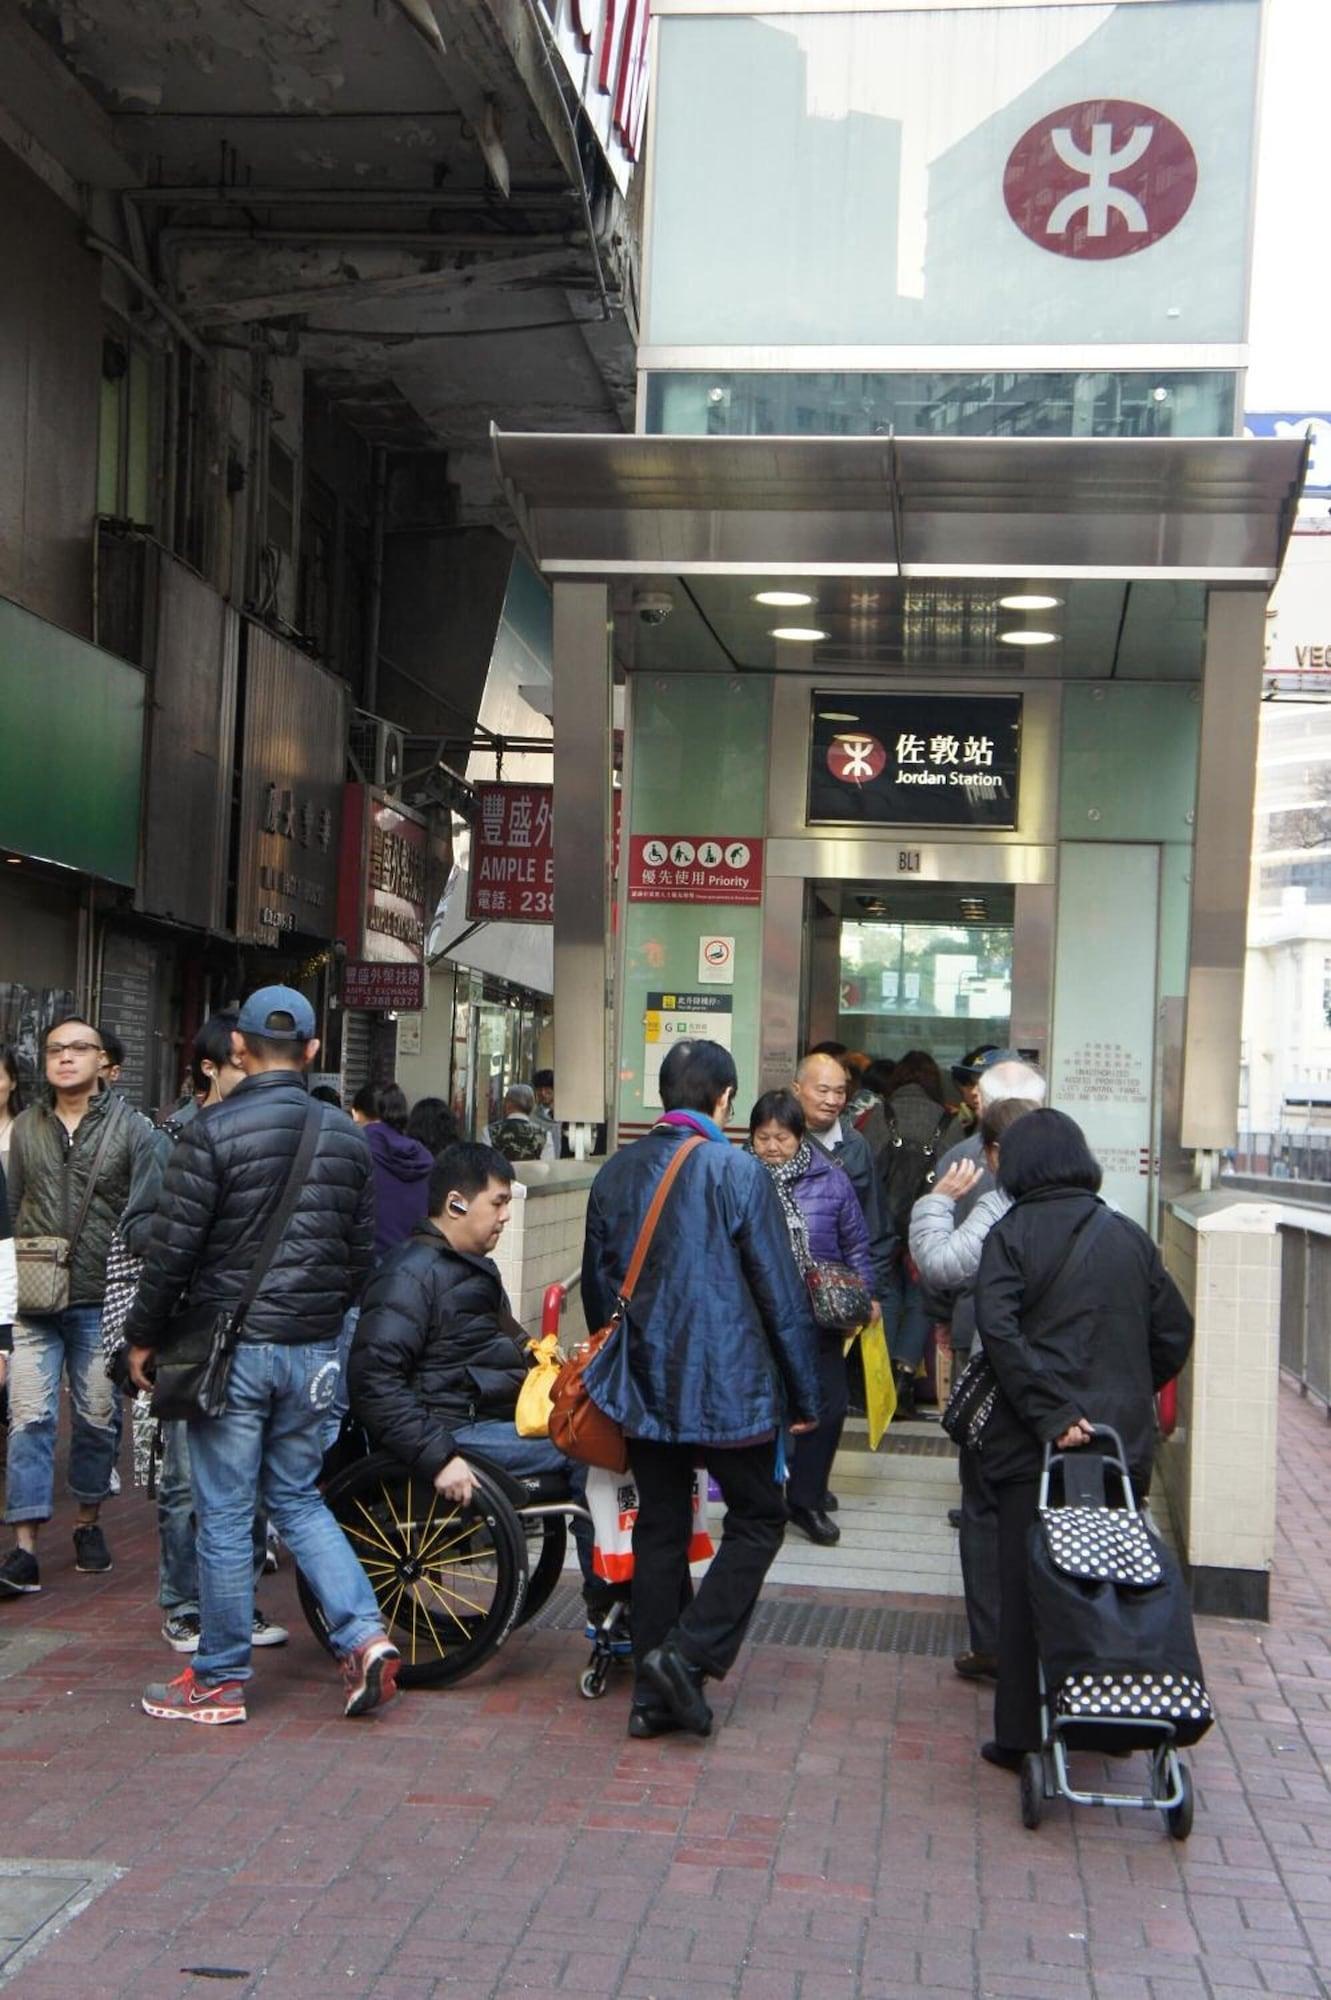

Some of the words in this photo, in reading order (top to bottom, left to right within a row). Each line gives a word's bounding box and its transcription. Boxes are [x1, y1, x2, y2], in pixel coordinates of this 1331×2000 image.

[895, 733, 994, 766] 佐敦站
[895, 770, 946, 785] Jordan
[949, 771, 1002, 786] Station
[480, 856, 535, 882] AMPLE
[899, 852, 920, 870] BL1
[642, 869, 705, 885] 優先使用
[708, 875, 749, 889] Priority
[346, 985, 372, 995] AMPLE
[374, 986, 418, 996] EXCHANGE
[393, 996, 419, 1007] 6377
[665, 1023, 673, 1032] G
